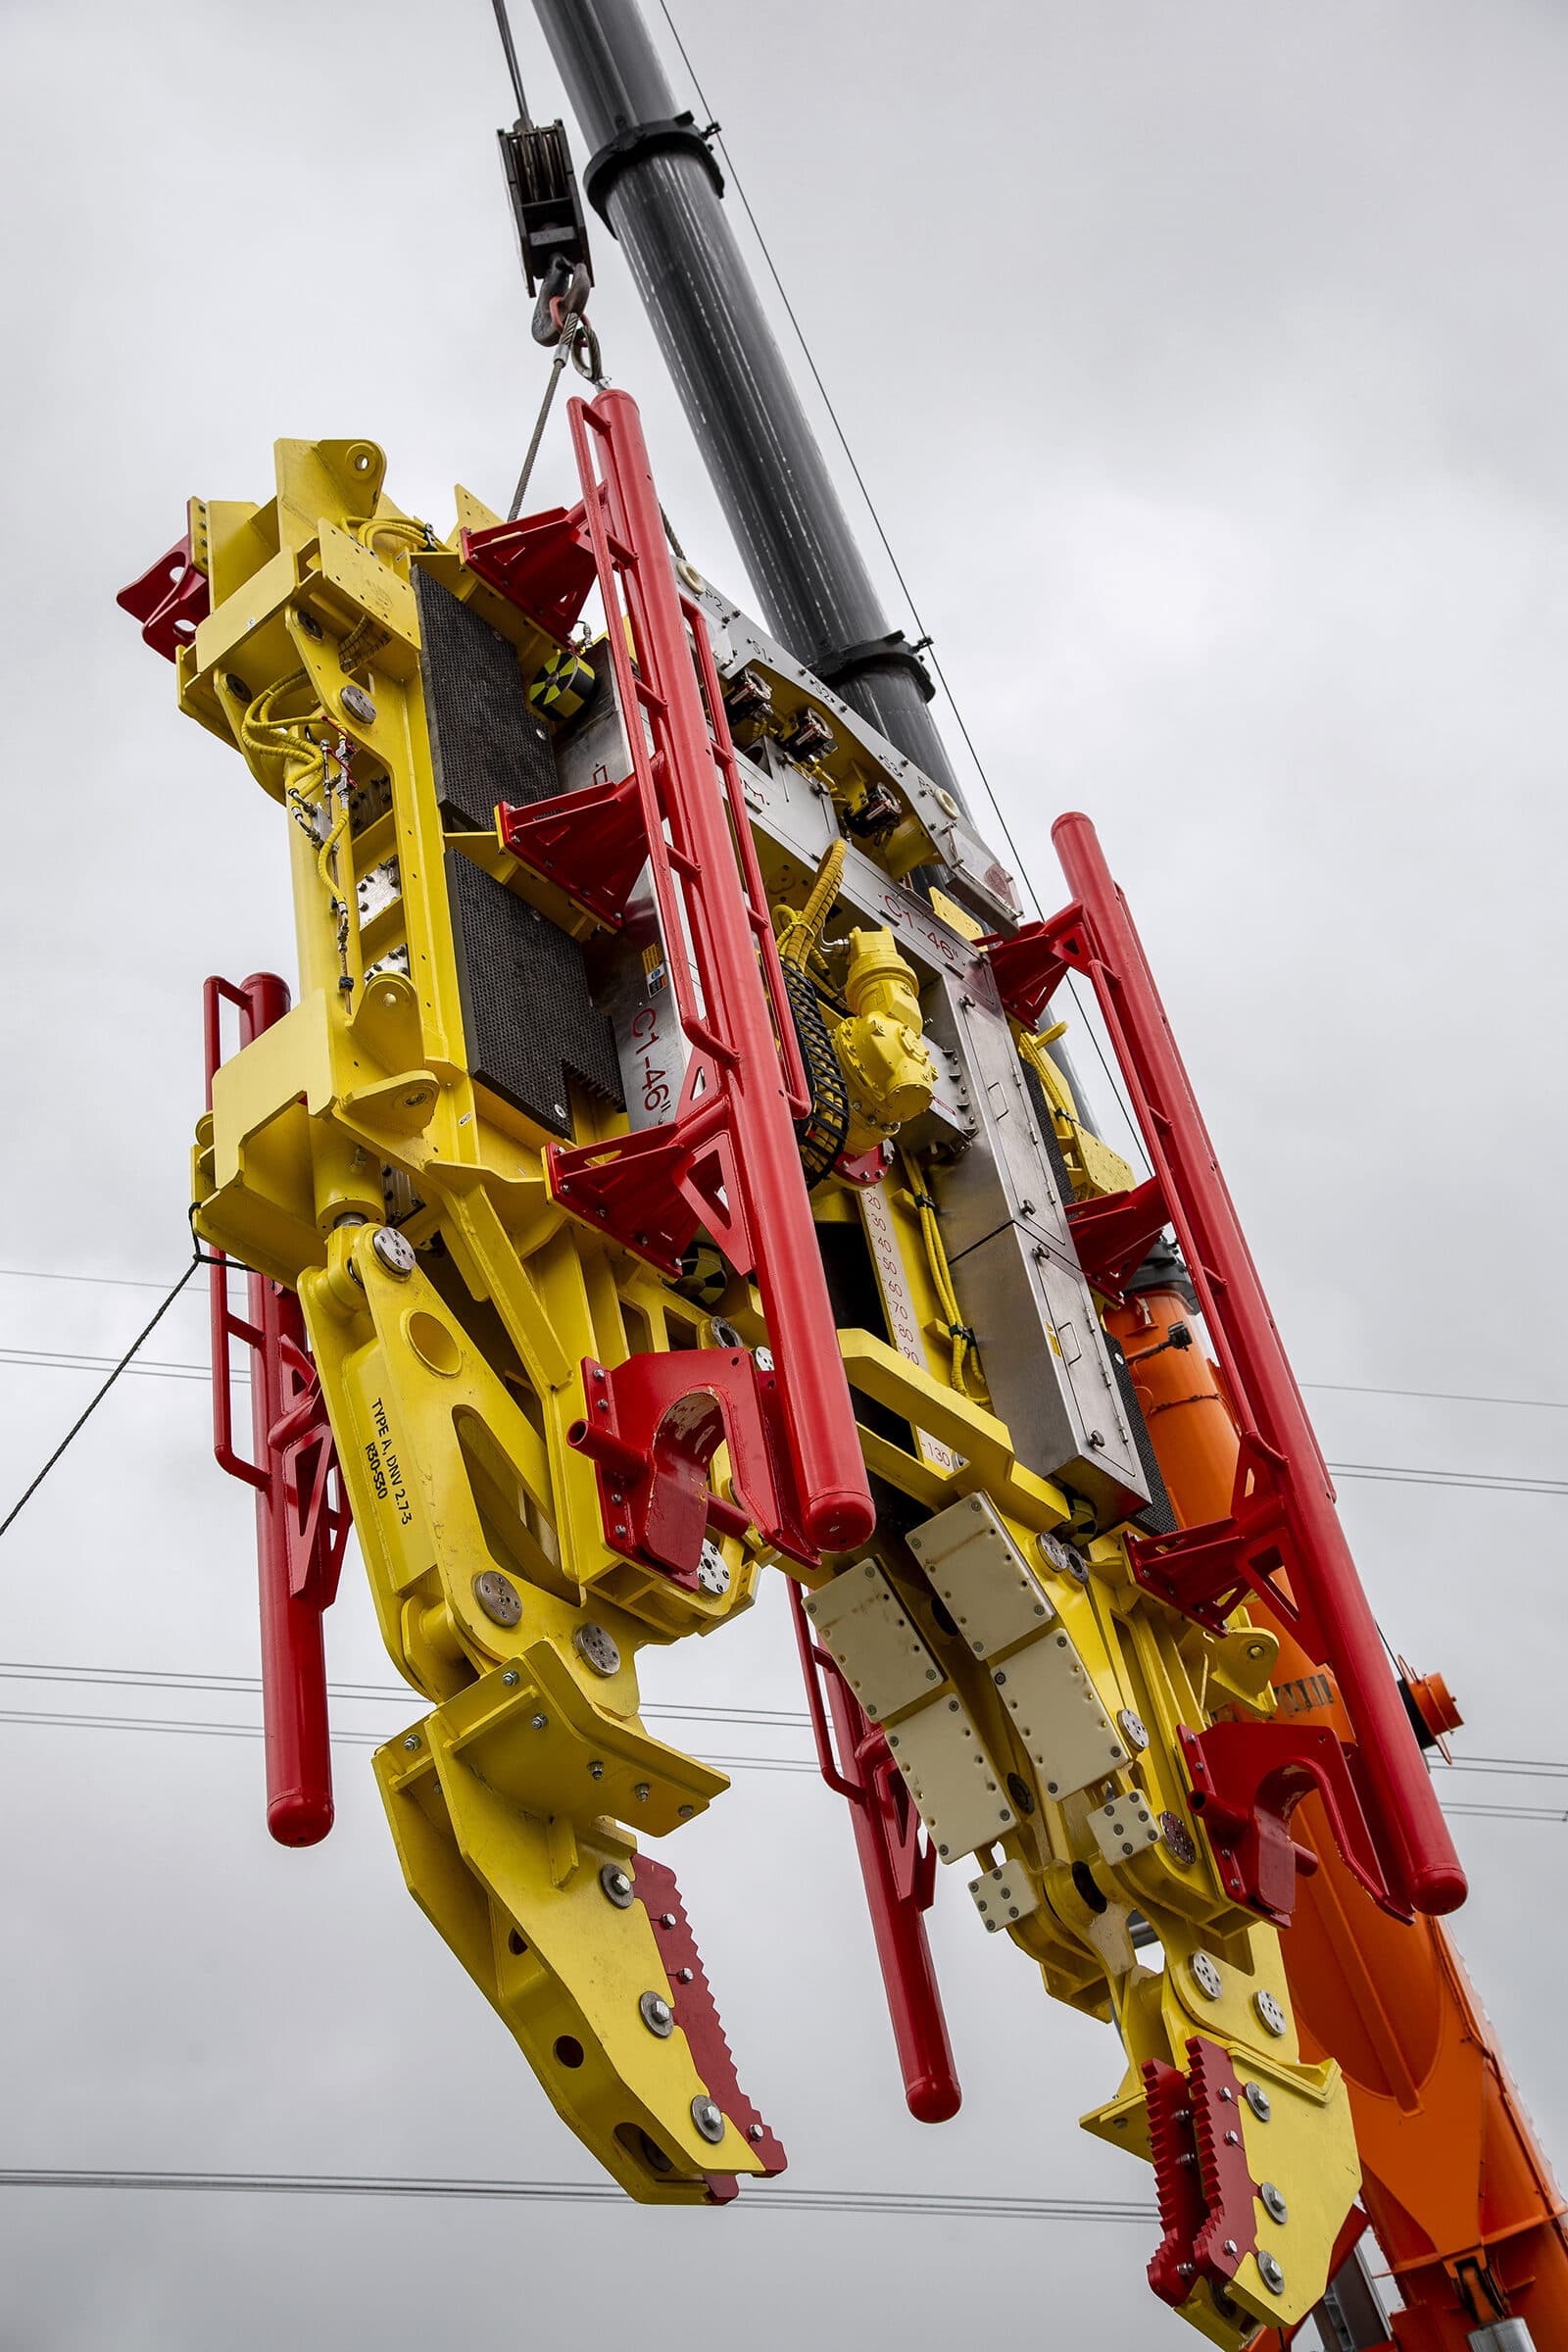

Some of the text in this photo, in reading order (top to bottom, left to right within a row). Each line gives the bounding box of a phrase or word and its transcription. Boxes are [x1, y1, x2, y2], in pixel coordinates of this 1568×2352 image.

[365, 1442, 389, 1500] R30-S30
[371, 1396, 413, 1526] TYPE A, DNV 2.7-3
